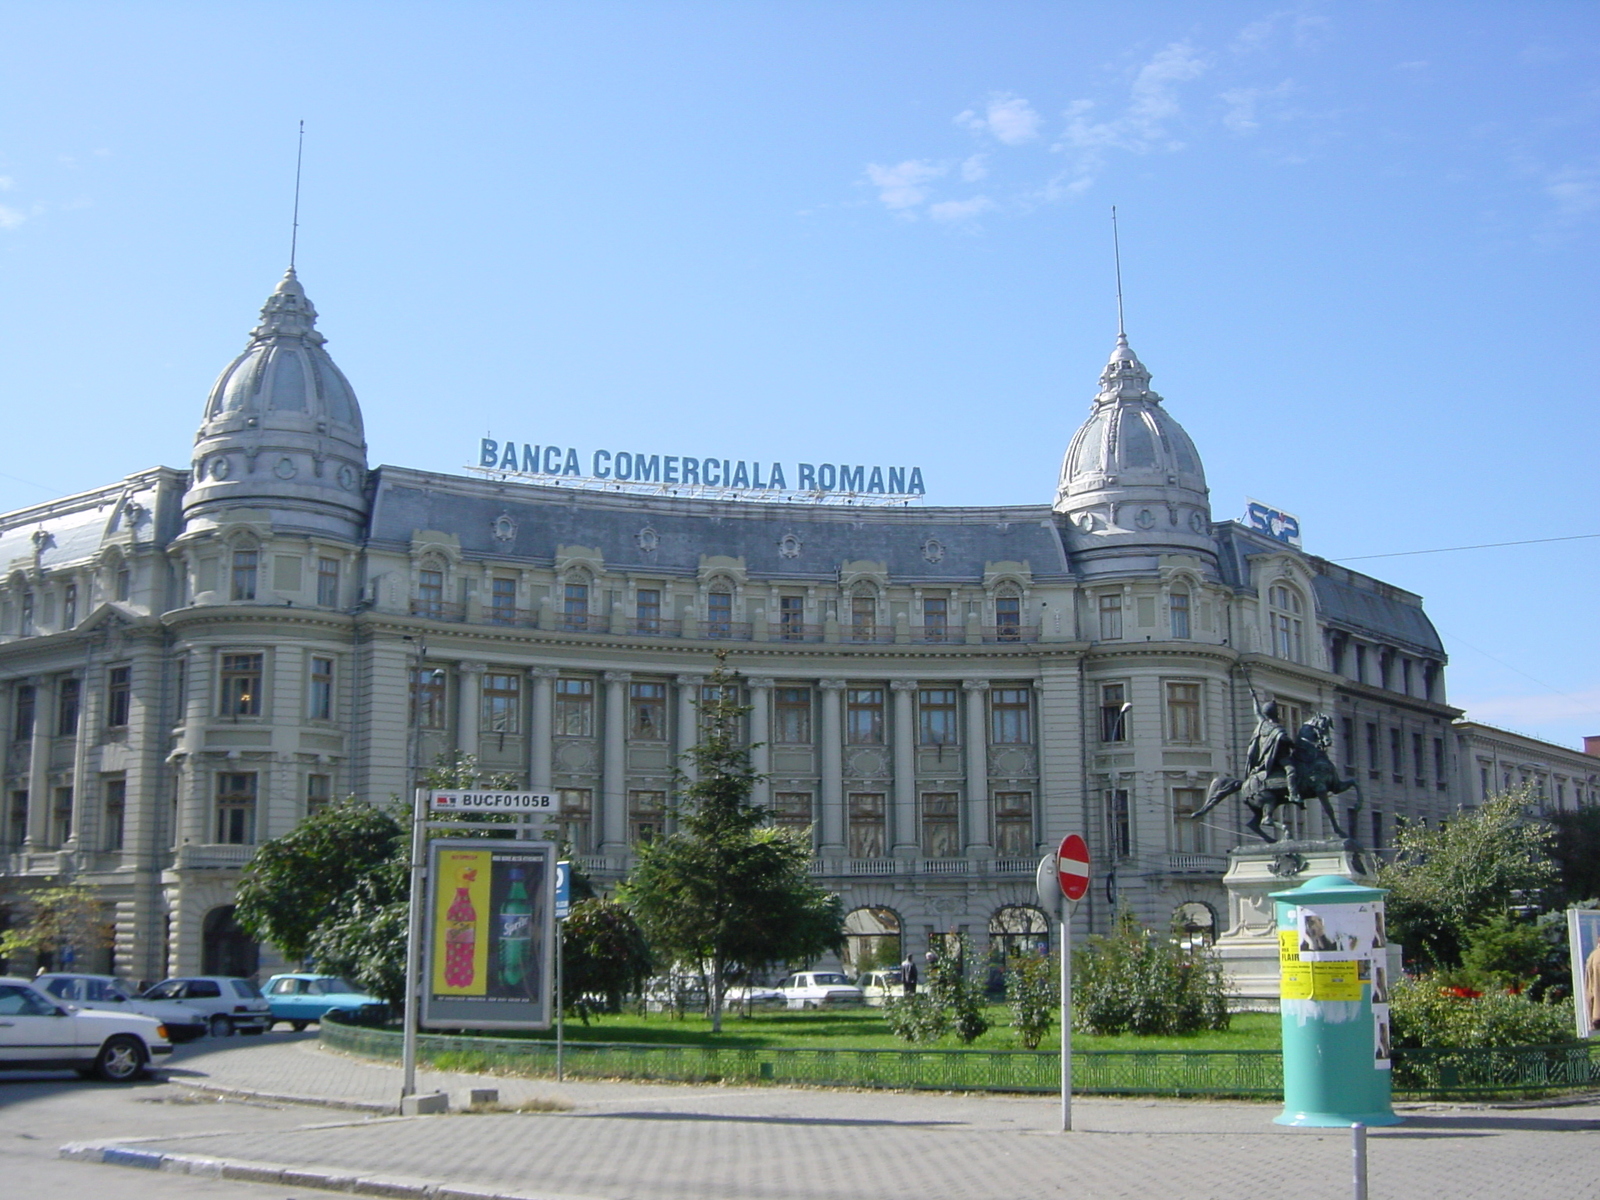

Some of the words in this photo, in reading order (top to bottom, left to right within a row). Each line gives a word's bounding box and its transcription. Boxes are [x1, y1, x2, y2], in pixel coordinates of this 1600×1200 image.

[479, 438, 581, 476] BANCA
[592, 449, 787, 489] COMERCIALA
[797, 462, 926, 494] ROMANA
[463, 794, 550, 807] BUCF0105B
